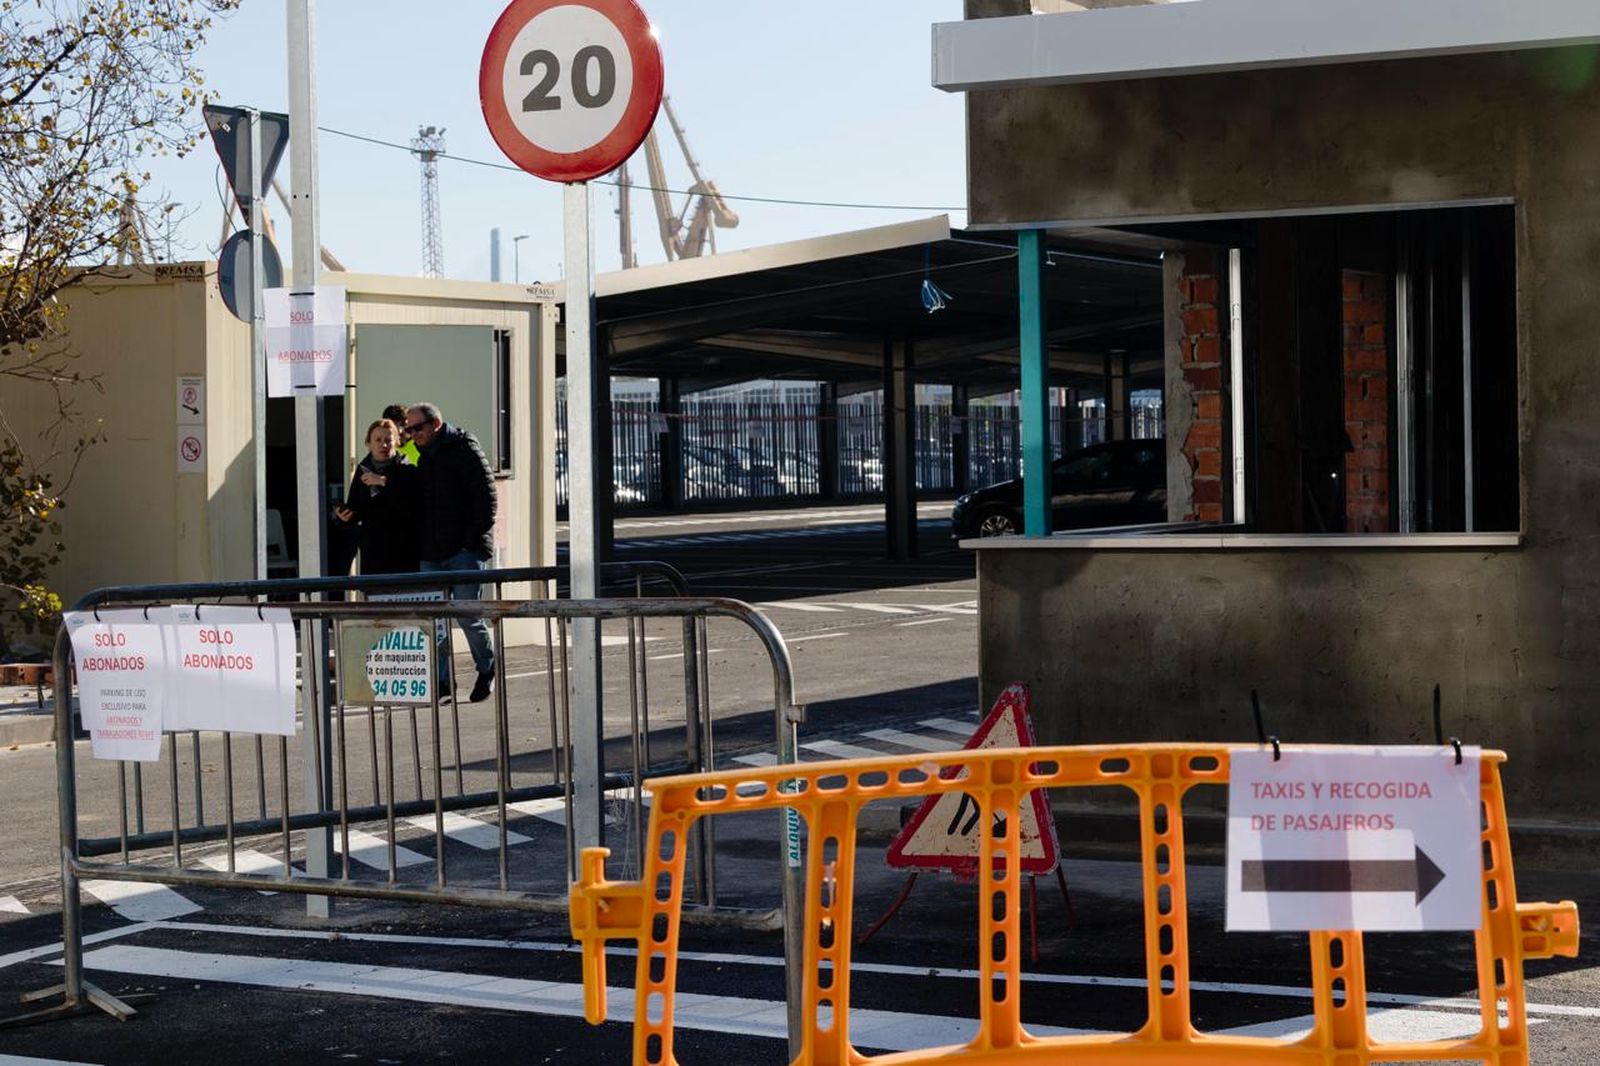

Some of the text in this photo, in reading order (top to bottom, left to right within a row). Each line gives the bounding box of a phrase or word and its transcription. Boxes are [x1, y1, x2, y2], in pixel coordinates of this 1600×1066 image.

[519, 44, 616, 113] 20
[289, 310, 314, 322] SOLO
[278, 349, 333, 361] ABONADOS
[94, 633, 126, 647] SOLO
[199, 629, 234, 645] SOLO
[82, 655, 145, 672] ABONADOS
[183, 653, 254, 671] ABONADOS
[374, 652, 383, 662] de
[385, 652, 426, 664] maquinaria
[373, 679, 427, 697] 34 05 96
[1251, 781, 1432, 799] TAXIS Y RECOGIDA
[1251, 813, 1395, 831] DE PASAJEROS
